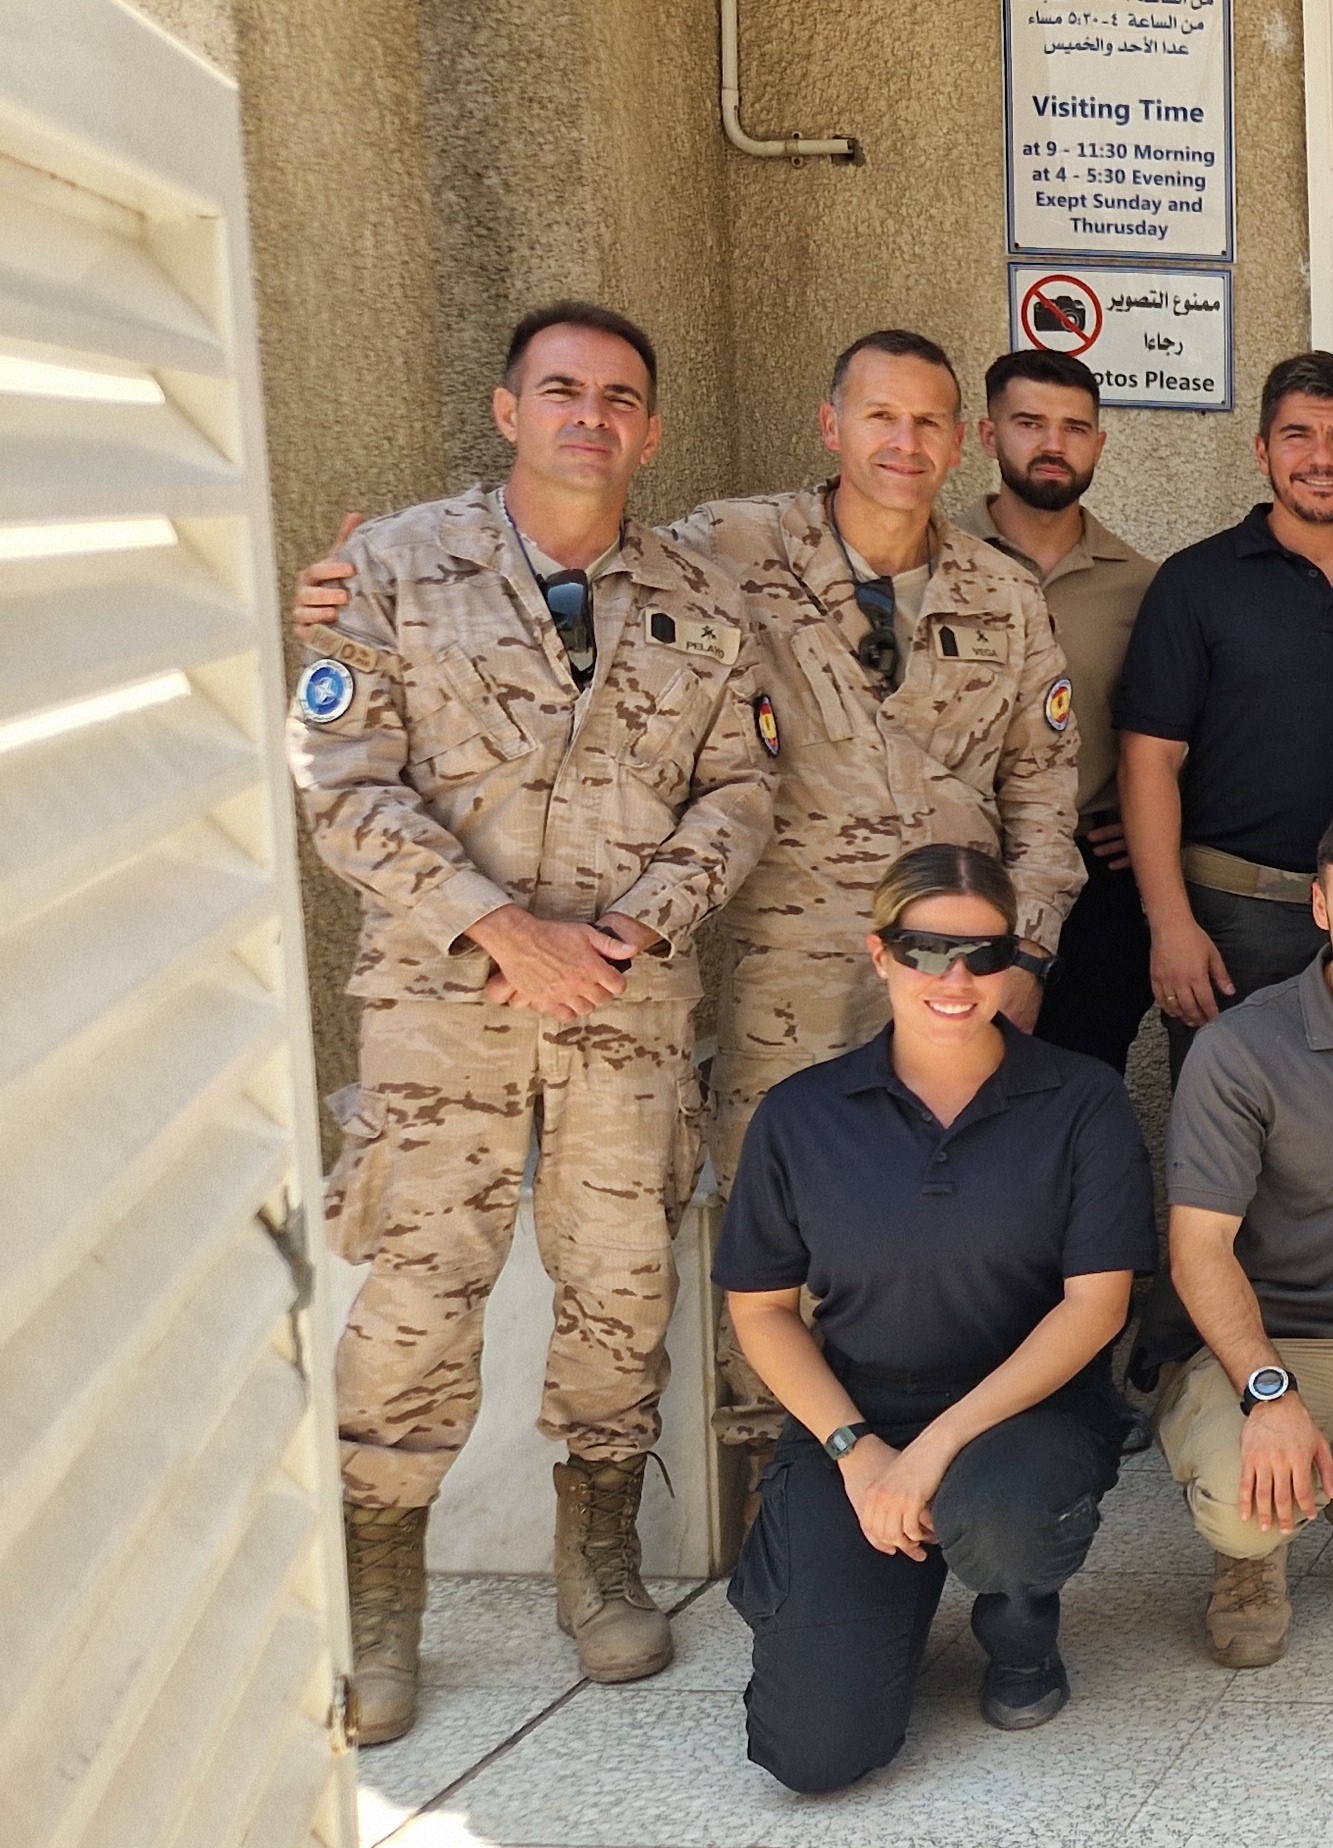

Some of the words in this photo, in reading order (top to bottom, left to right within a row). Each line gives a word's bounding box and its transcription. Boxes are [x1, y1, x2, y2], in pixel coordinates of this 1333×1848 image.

[1028, 9, 1063, 25] مساء
[1127, 12, 1178, 30] الساعة
[1180, 19, 1205, 36] من
[1043, 36, 1114, 57] والخميس
[1117, 36, 1158, 54] الأحد
[1162, 40, 1189, 56] عدا
[1031, 94, 1130, 127] Visiting
[1138, 98, 1205, 124] Time
[1022, 141, 1041, 157] at
[1046, 140, 1057, 157] 9
[1076, 142, 1128, 160] 11:30
[1133, 143, 1215, 168] Morning
[1031, 167, 1051, 182] at
[1055, 166, 1068, 183] 4
[1086, 167, 1126, 185] 5:30
[1132, 169, 1206, 193] Evening
[1035, 190, 1088, 213] Exept
[1092, 192, 1162, 216] Sunday
[1167, 196, 1203, 213] and
[1069, 216, 1169, 241] Thurusday
[1105, 289, 1169, 313] التصوير
[1172, 292, 1221, 317] ممنوع
[1092, 369, 1138, 388] otos
[1145, 370, 1215, 393] Please
[971, 647, 999, 657] VEGA
